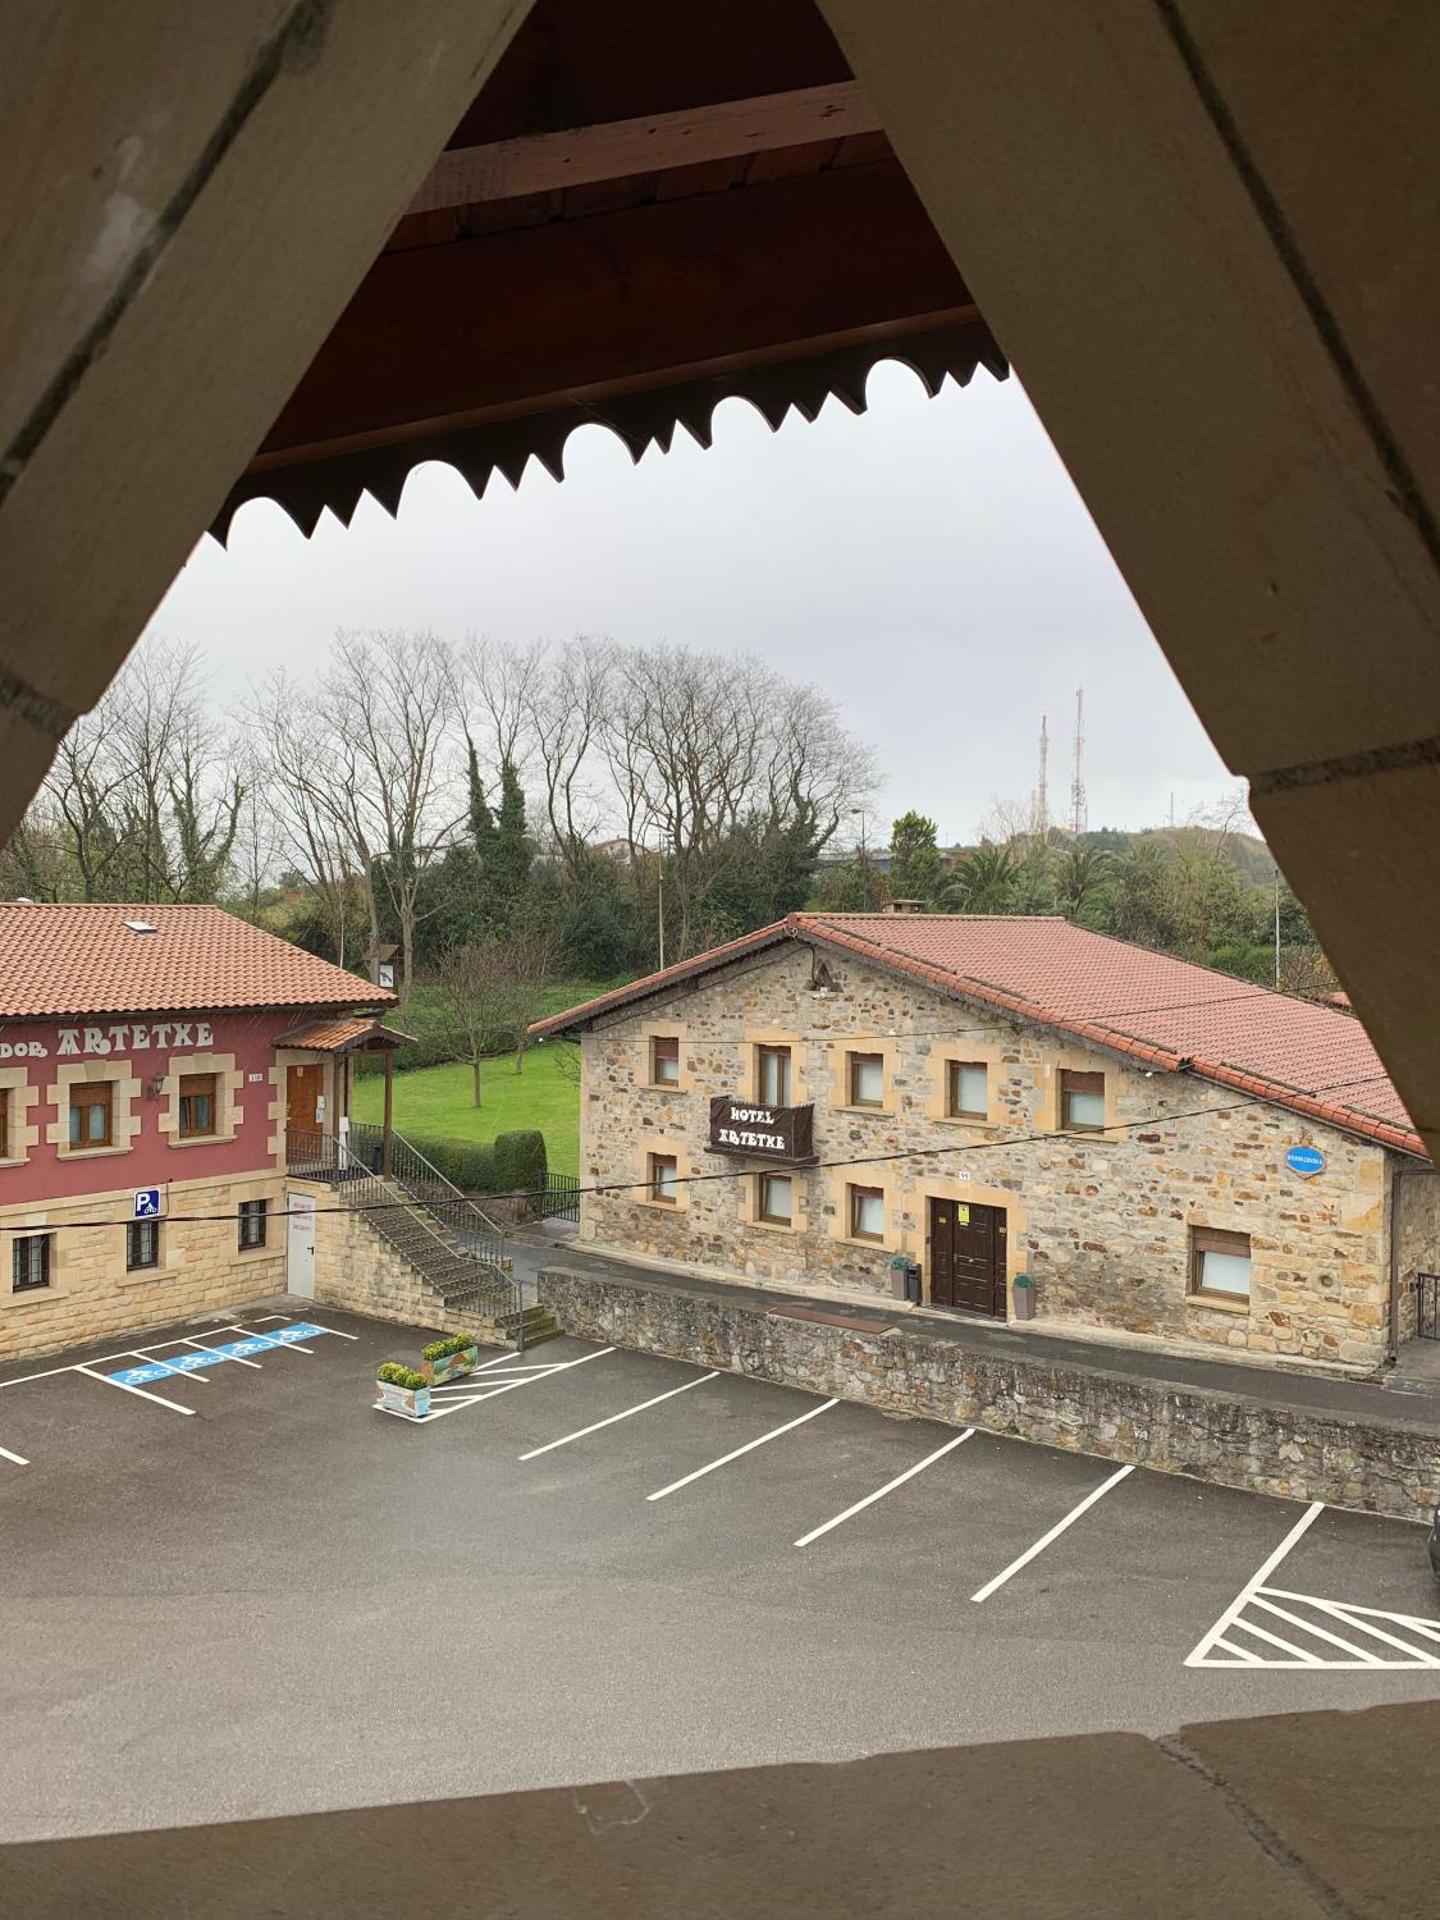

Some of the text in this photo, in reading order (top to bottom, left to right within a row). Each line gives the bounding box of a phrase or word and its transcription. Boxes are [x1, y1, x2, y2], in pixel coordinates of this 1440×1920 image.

[56, 1022, 214, 1055] ARTETXE
[730, 1107, 775, 1125] HOTEL
[718, 1128, 786, 1150] ARTETXE
[136, 1193, 151, 1212] P
